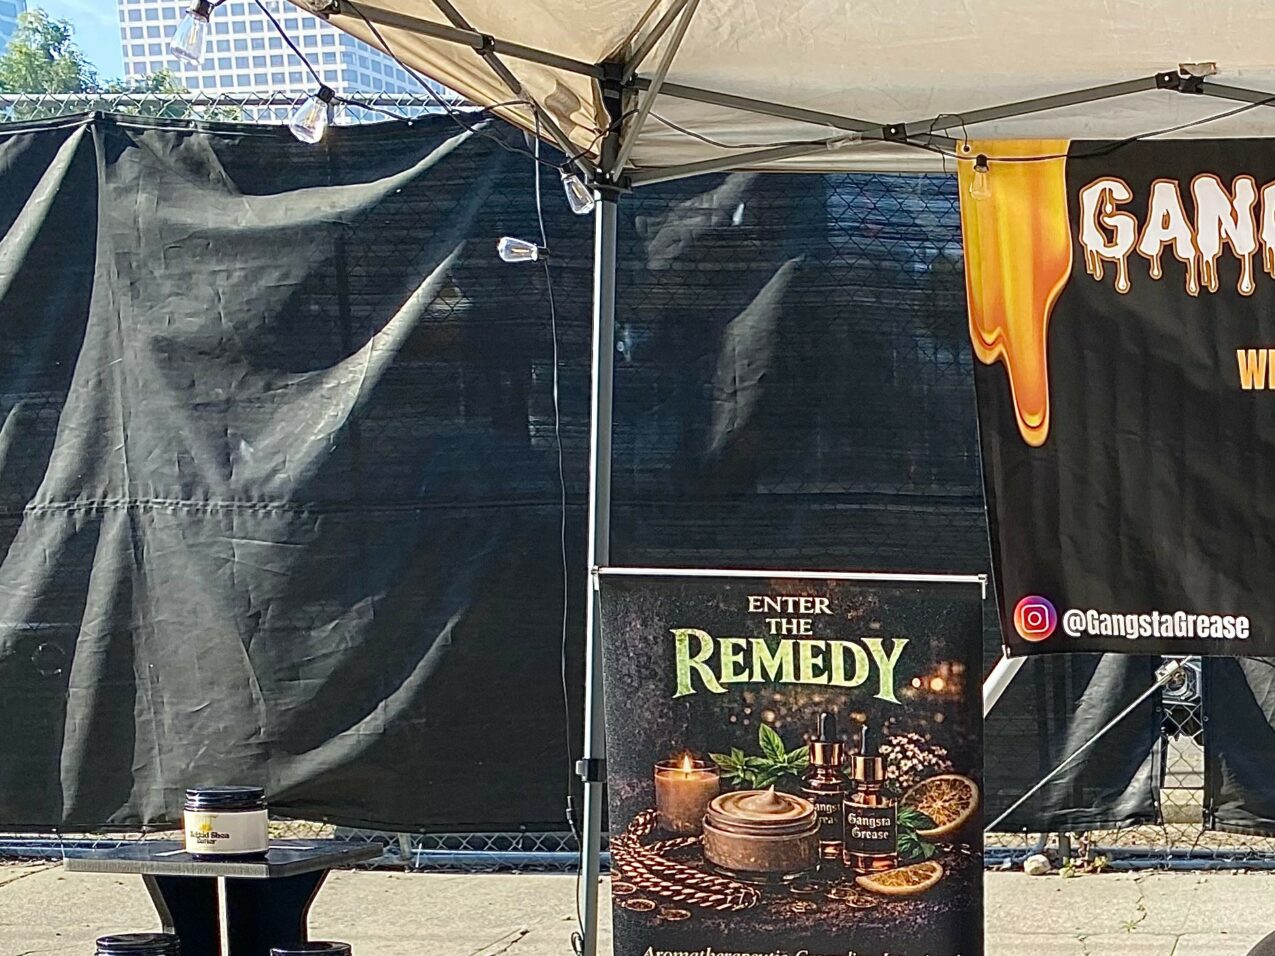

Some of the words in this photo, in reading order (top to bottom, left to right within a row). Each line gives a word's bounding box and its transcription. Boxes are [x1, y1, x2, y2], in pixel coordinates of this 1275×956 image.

[747, 595, 832, 615] ENTER
[765, 617, 813, 636] THE
[1062, 608, 1249, 639] @GangstaGrease
[669, 628, 910, 704] REMEDY
[814, 803, 841, 814] angst
[847, 813, 891, 828] Gangsta
[852, 826, 889, 839] Grease
